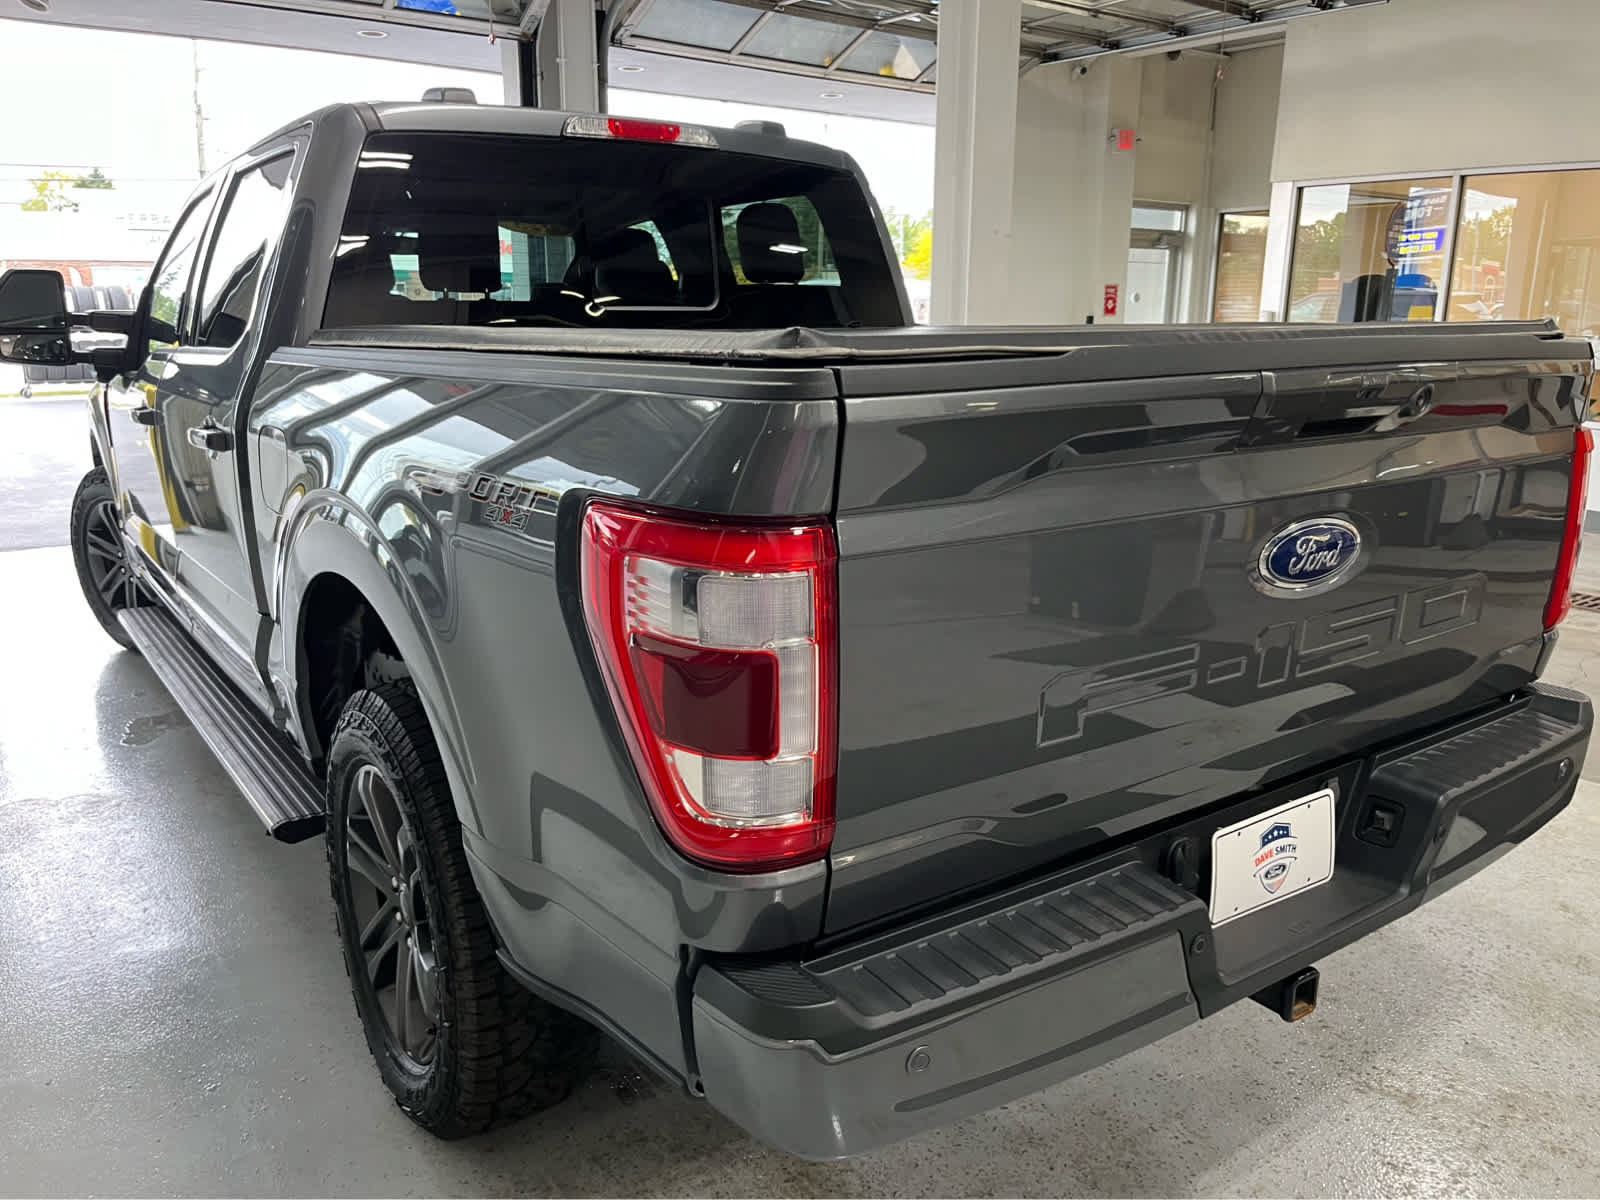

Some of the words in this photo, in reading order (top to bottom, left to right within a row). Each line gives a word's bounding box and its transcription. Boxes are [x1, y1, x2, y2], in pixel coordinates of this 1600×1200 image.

[1288, 534, 1342, 575] Ford
[1037, 572, 1487, 747] F-150
[1255, 848, 1274, 867] DAVE
[1275, 844, 1297, 855] SMITH
